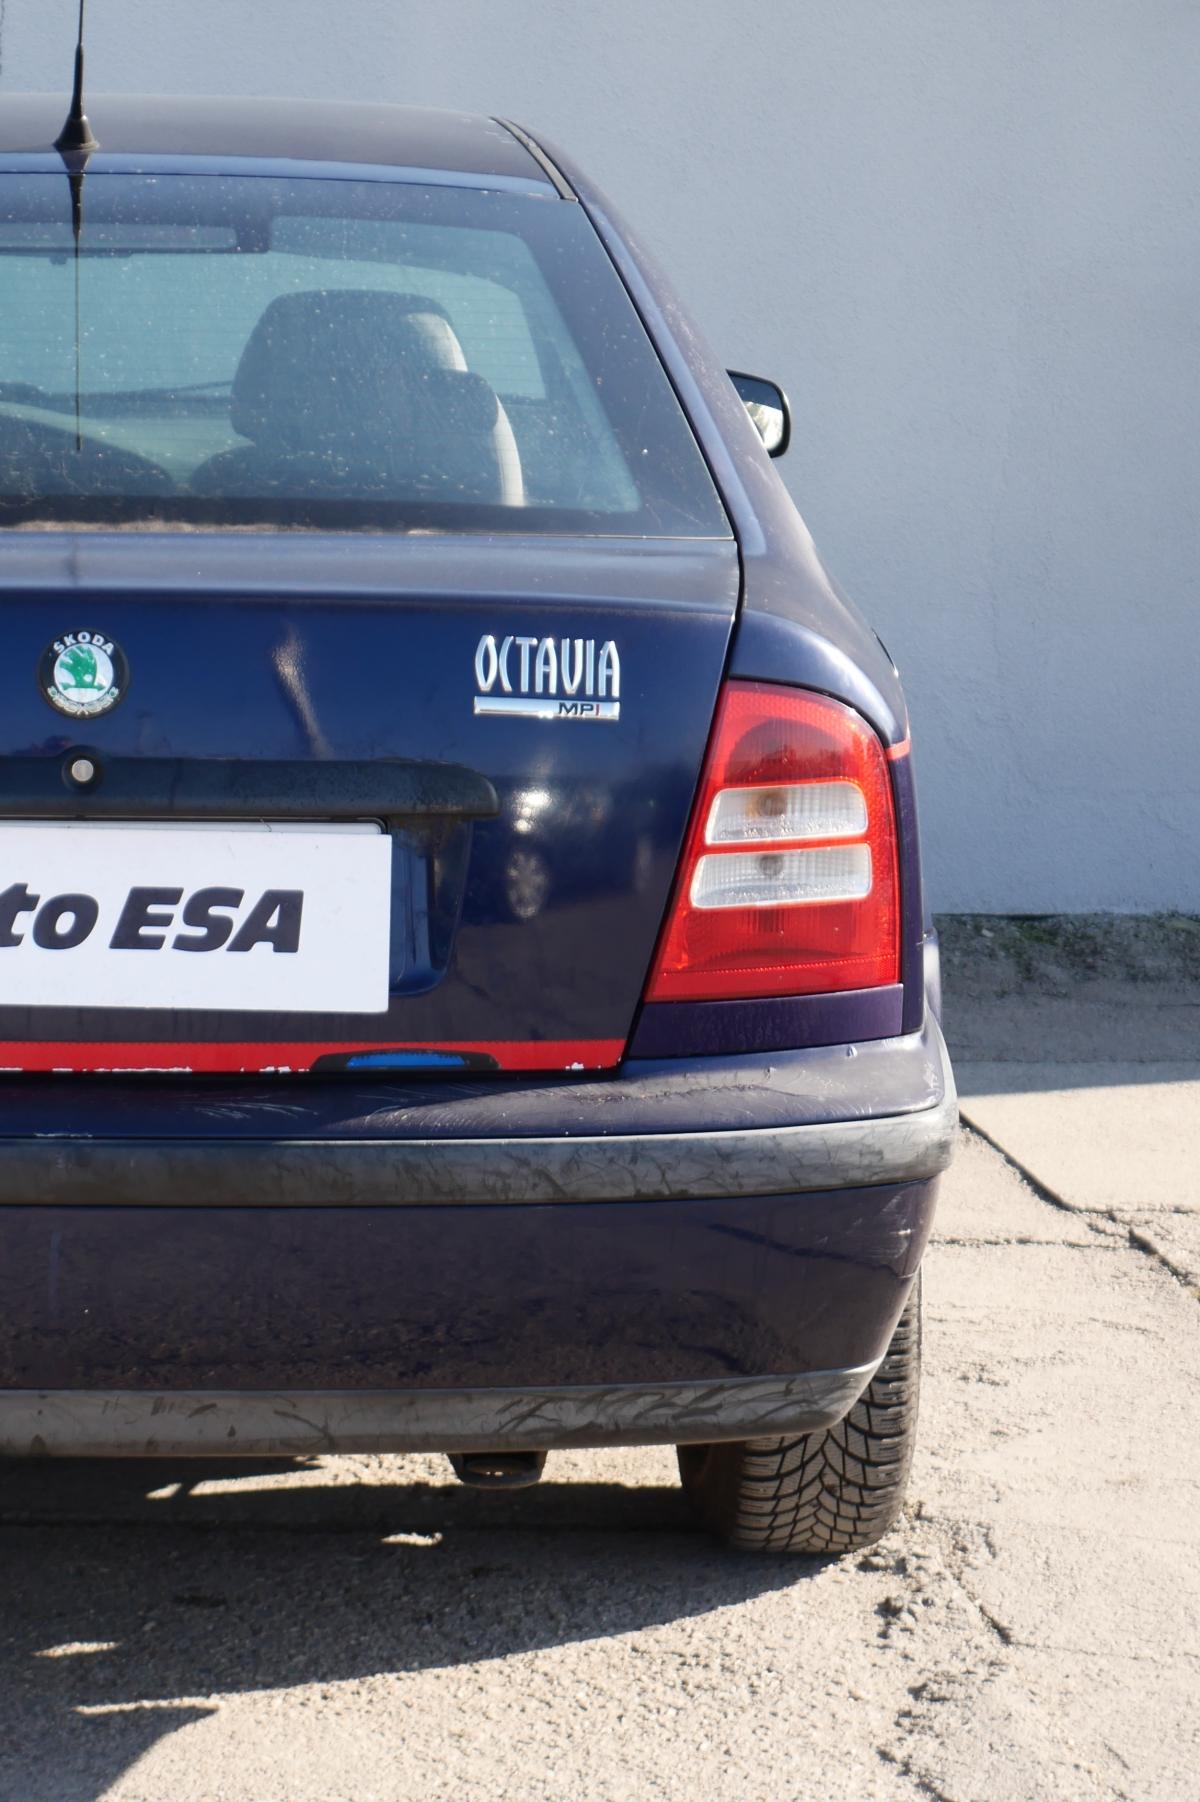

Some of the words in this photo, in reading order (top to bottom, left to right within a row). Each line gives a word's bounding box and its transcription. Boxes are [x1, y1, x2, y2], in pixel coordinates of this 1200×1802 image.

[475, 635, 620, 697] OCTAVIA
[559, 703, 599, 716] MPI
[108, 887, 303, 953] ESA
